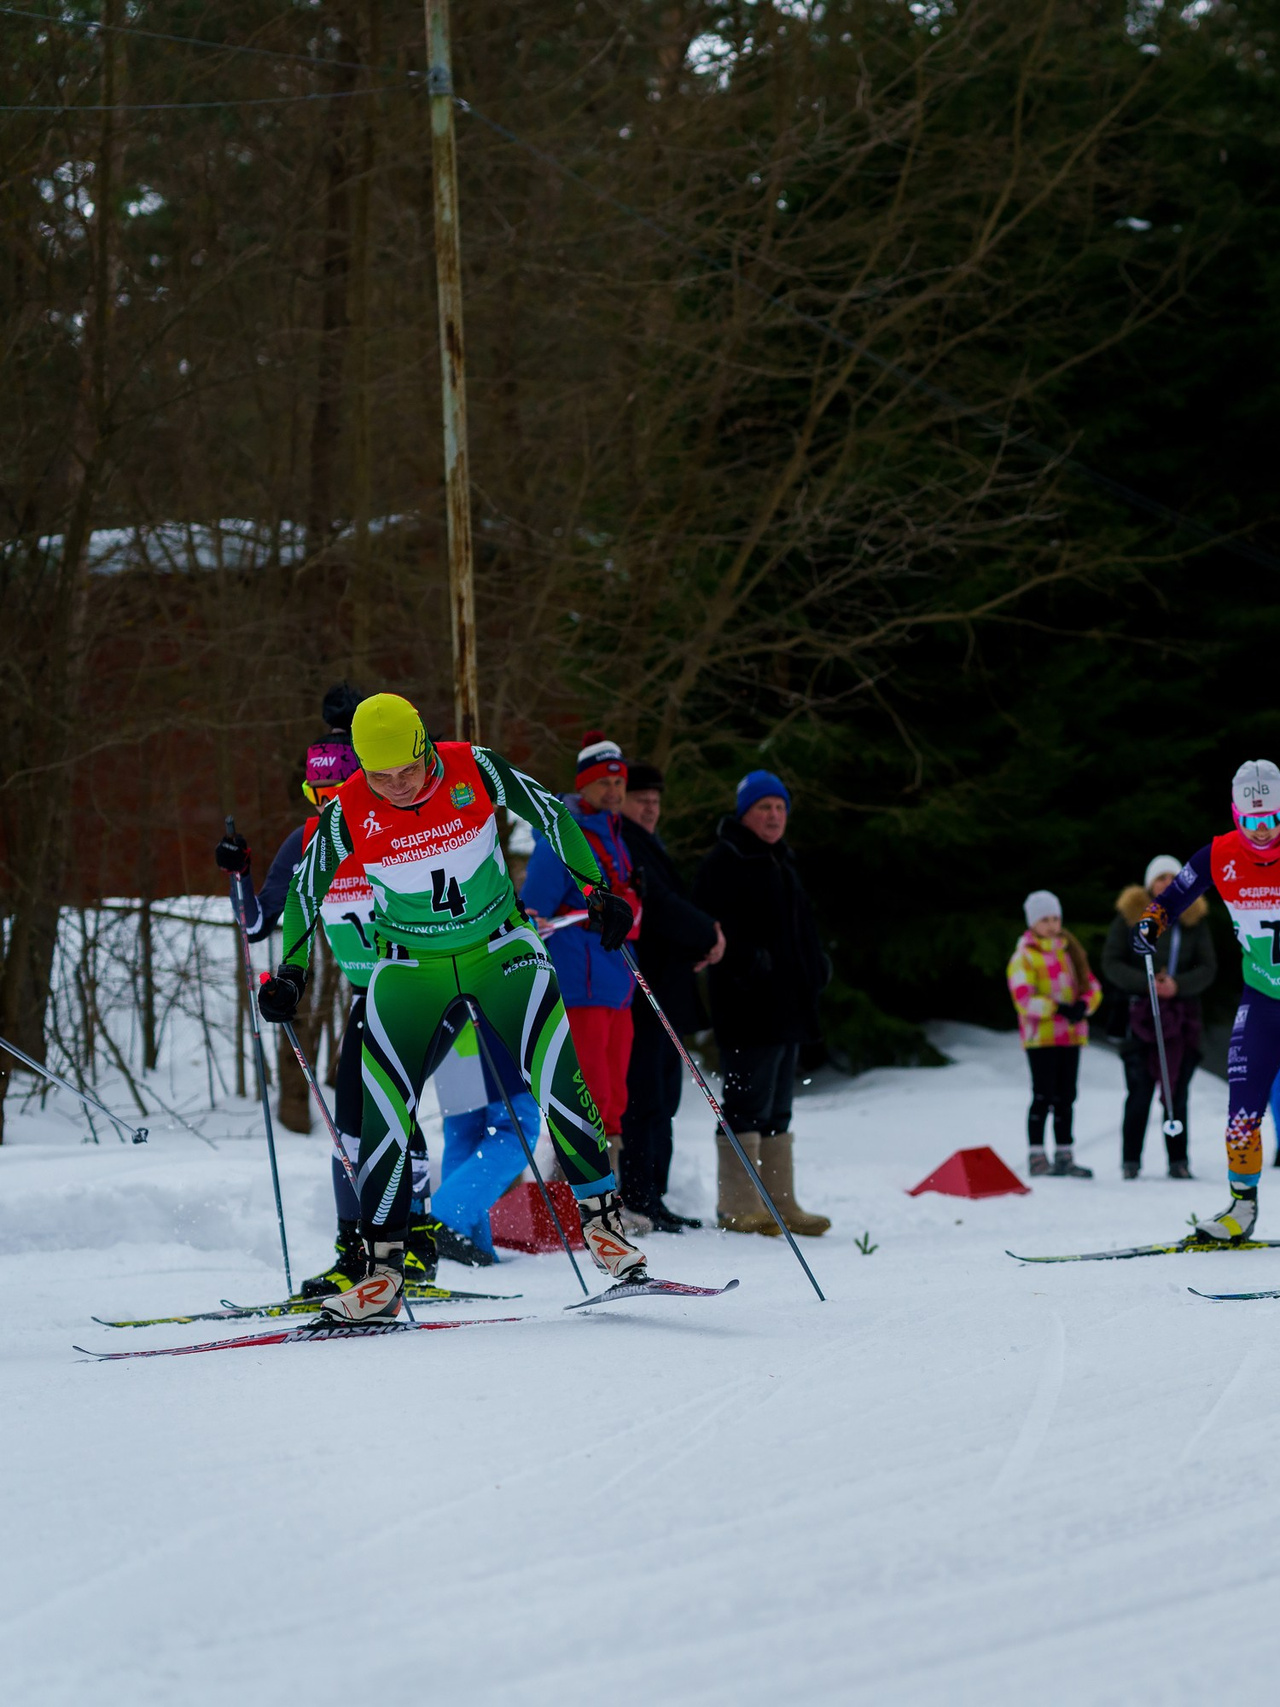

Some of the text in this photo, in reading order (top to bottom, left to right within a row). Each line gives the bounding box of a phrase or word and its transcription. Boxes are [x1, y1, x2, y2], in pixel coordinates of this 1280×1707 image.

[309, 756, 336, 768] RAY
[1243, 780, 1270, 799] DNB
[390, 818, 464, 850] ФЕДЕРАЦИЯ
[381, 825, 481, 868] ЛЫЖНЫХ ГОНОК
[324, 889, 364, 903] ЫЖНЫХ
[430, 868, 467, 918] 4
[572, 1068, 607, 1153] RUSSIA
[404, 1286, 452, 1300] CHER
[600, 1284, 650, 1301] MADSHUS
[283, 1322, 420, 1344] MADSHUS
